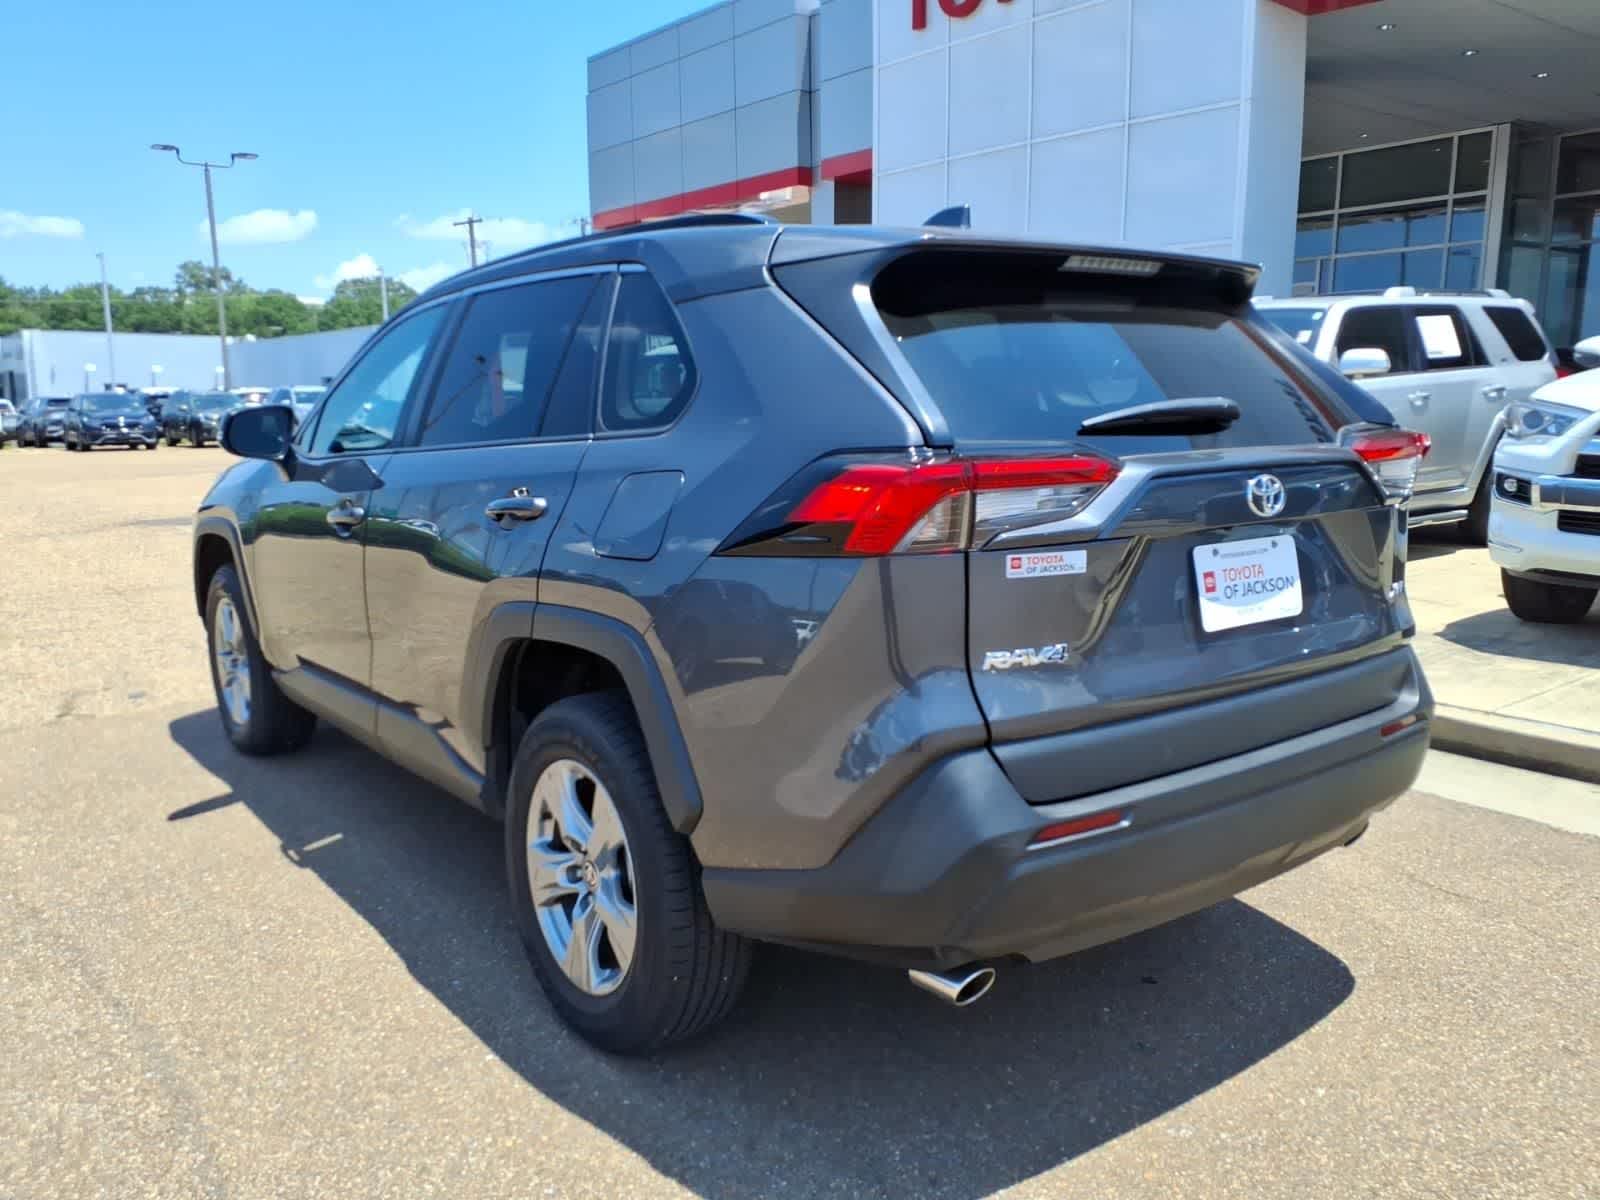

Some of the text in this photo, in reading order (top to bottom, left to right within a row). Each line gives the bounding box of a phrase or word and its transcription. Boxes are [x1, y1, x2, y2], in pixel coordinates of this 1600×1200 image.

[1026, 555, 1064, 565] TOYOTA
[1039, 563, 1074, 573] JACKSON
[1222, 563, 1265, 583] TOYOTA
[1224, 575, 1295, 600] OF JACKSON
[982, 643, 1068, 673] RAV4
